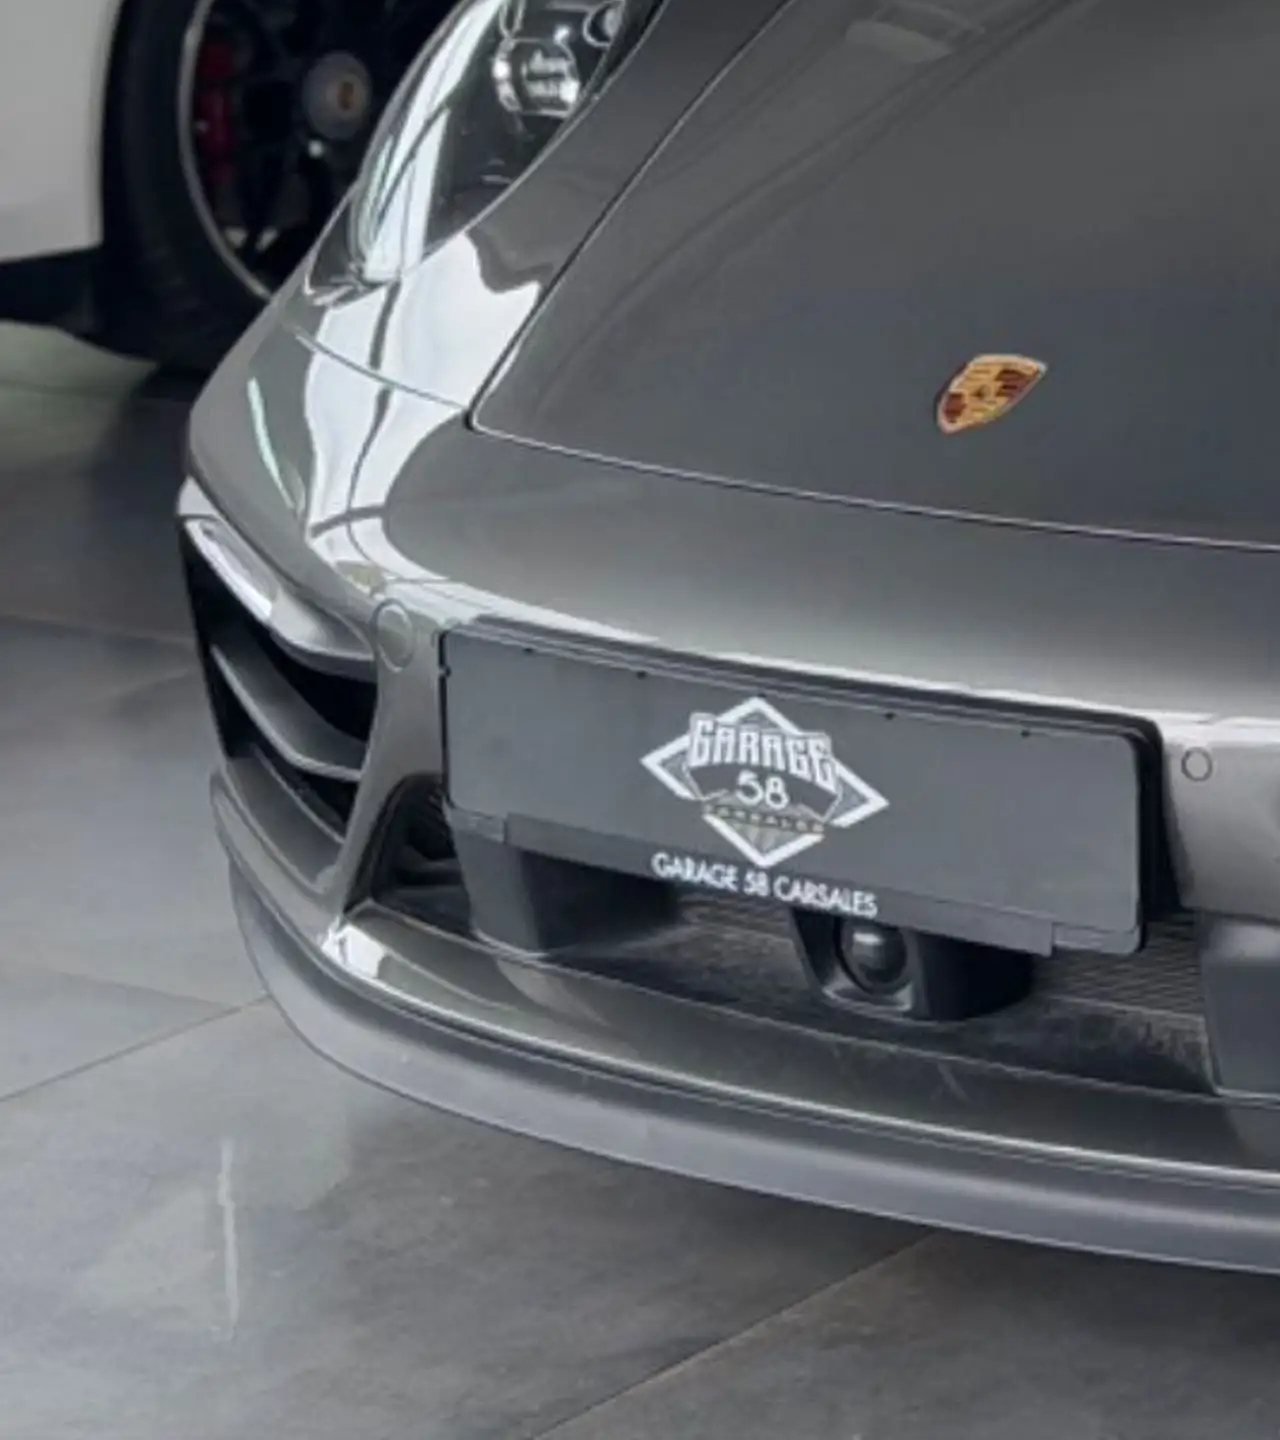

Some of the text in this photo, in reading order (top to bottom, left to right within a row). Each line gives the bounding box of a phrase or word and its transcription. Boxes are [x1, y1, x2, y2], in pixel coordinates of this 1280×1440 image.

[690, 717, 837, 794] GARAGE
[735, 770, 789, 810] 58
[651, 852, 878, 918] GARAGE 58 CARSALES
